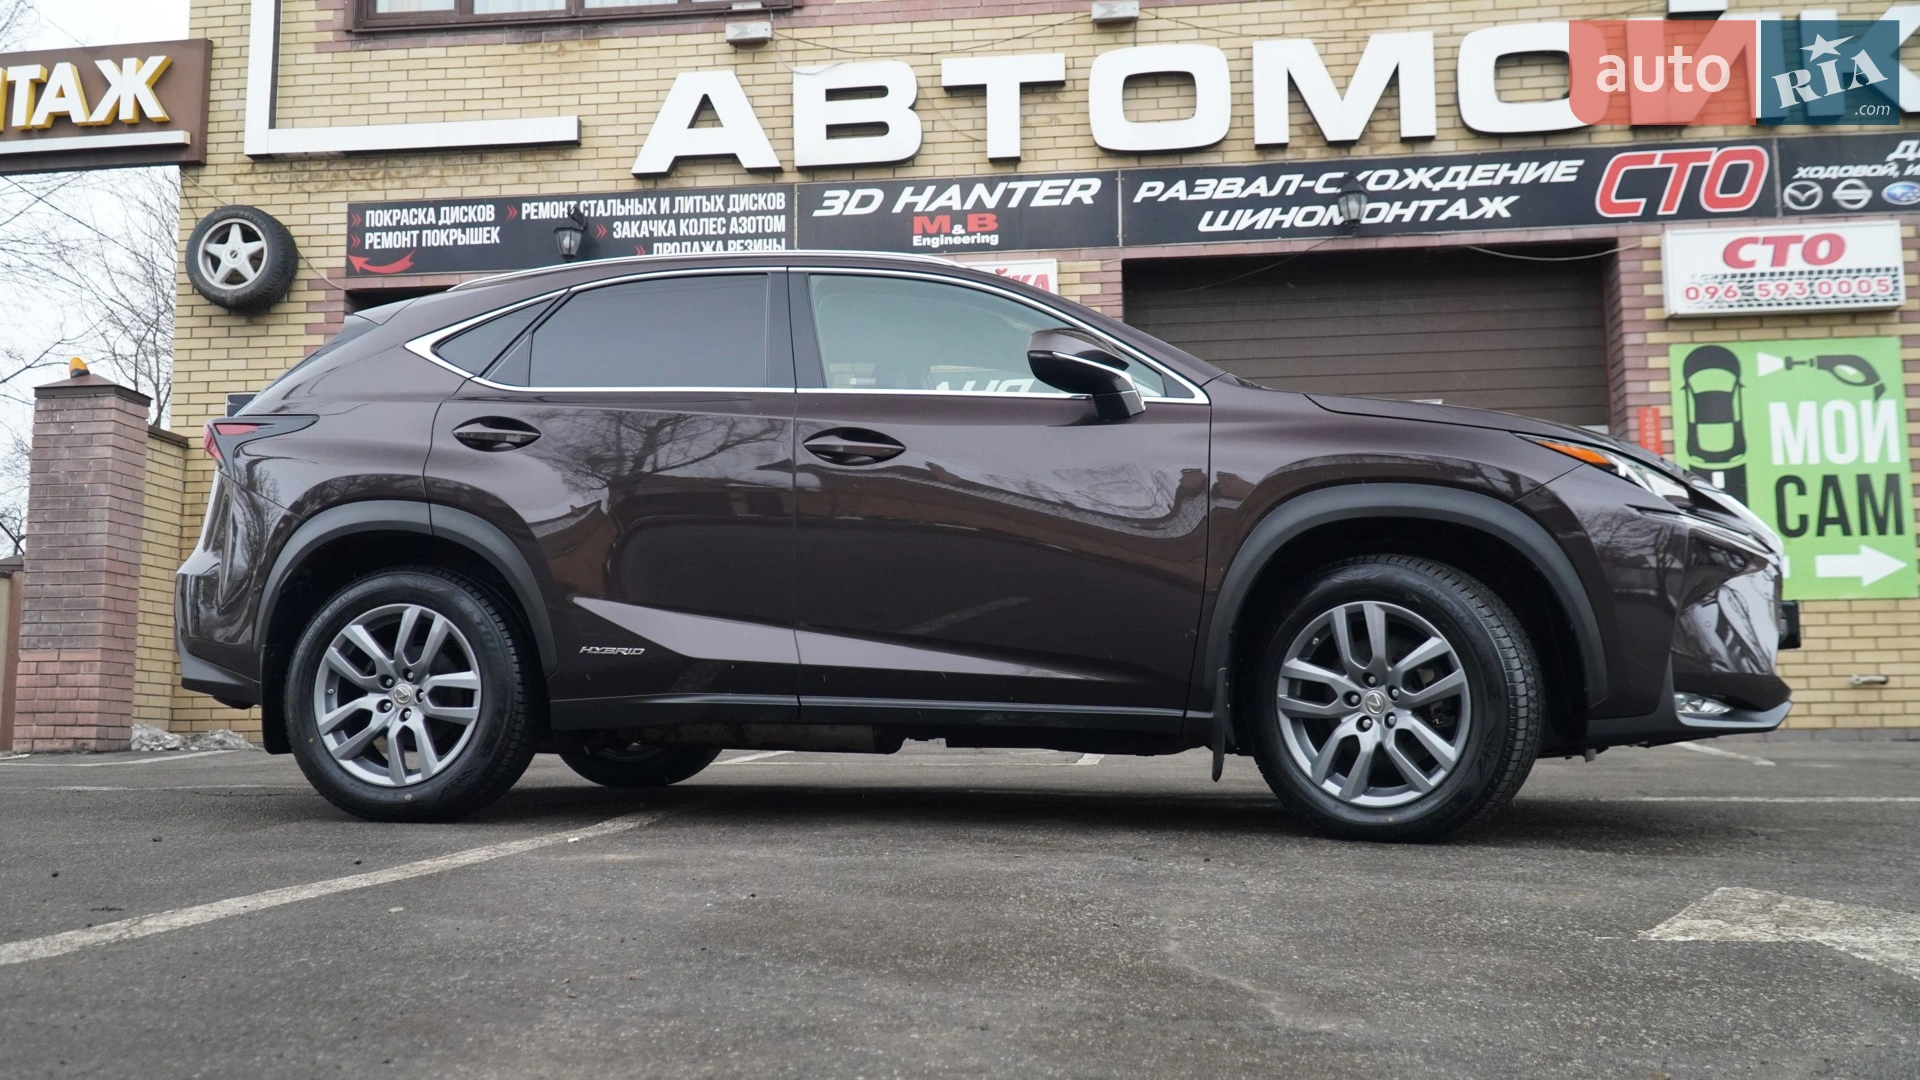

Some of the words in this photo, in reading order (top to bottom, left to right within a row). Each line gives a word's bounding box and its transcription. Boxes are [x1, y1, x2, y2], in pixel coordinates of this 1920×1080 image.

[0, 55, 172, 132] ТАЖ
[1595, 145, 1770, 218] СТО
[521, 201, 577, 220] РЕМОНТ
[580, 197, 657, 217] СТАЛЬНЫХ
[660, 197, 670, 214] И
[673, 194, 725, 214] ЛИТЫХ
[727, 192, 785, 213] ДИСКОВ
[812, 188, 885, 217] 3D
[892, 177, 1102, 214] HANTER
[365, 206, 436, 228] ПОКРАСКА
[438, 204, 495, 226] ДИСКОВ
[613, 217, 677, 238] ЗАКАЧКА
[680, 216, 731, 237] КОЛЕС
[731, 215, 785, 234] АЗОТОМ
[365, 230, 419, 249] РЕМОНТ
[422, 226, 500, 247] ПОКРЫШЕК
[912, 232, 999, 248] Engineering
[1722, 232, 1846, 269] СТО
[1685, 284, 1738, 300] 096
[1757, 281, 1807, 297] 593
[1817, 278, 1892, 296] 0005
[1775, 473, 1905, 538] САМ
[579, 646, 645, 656] HYBRID
